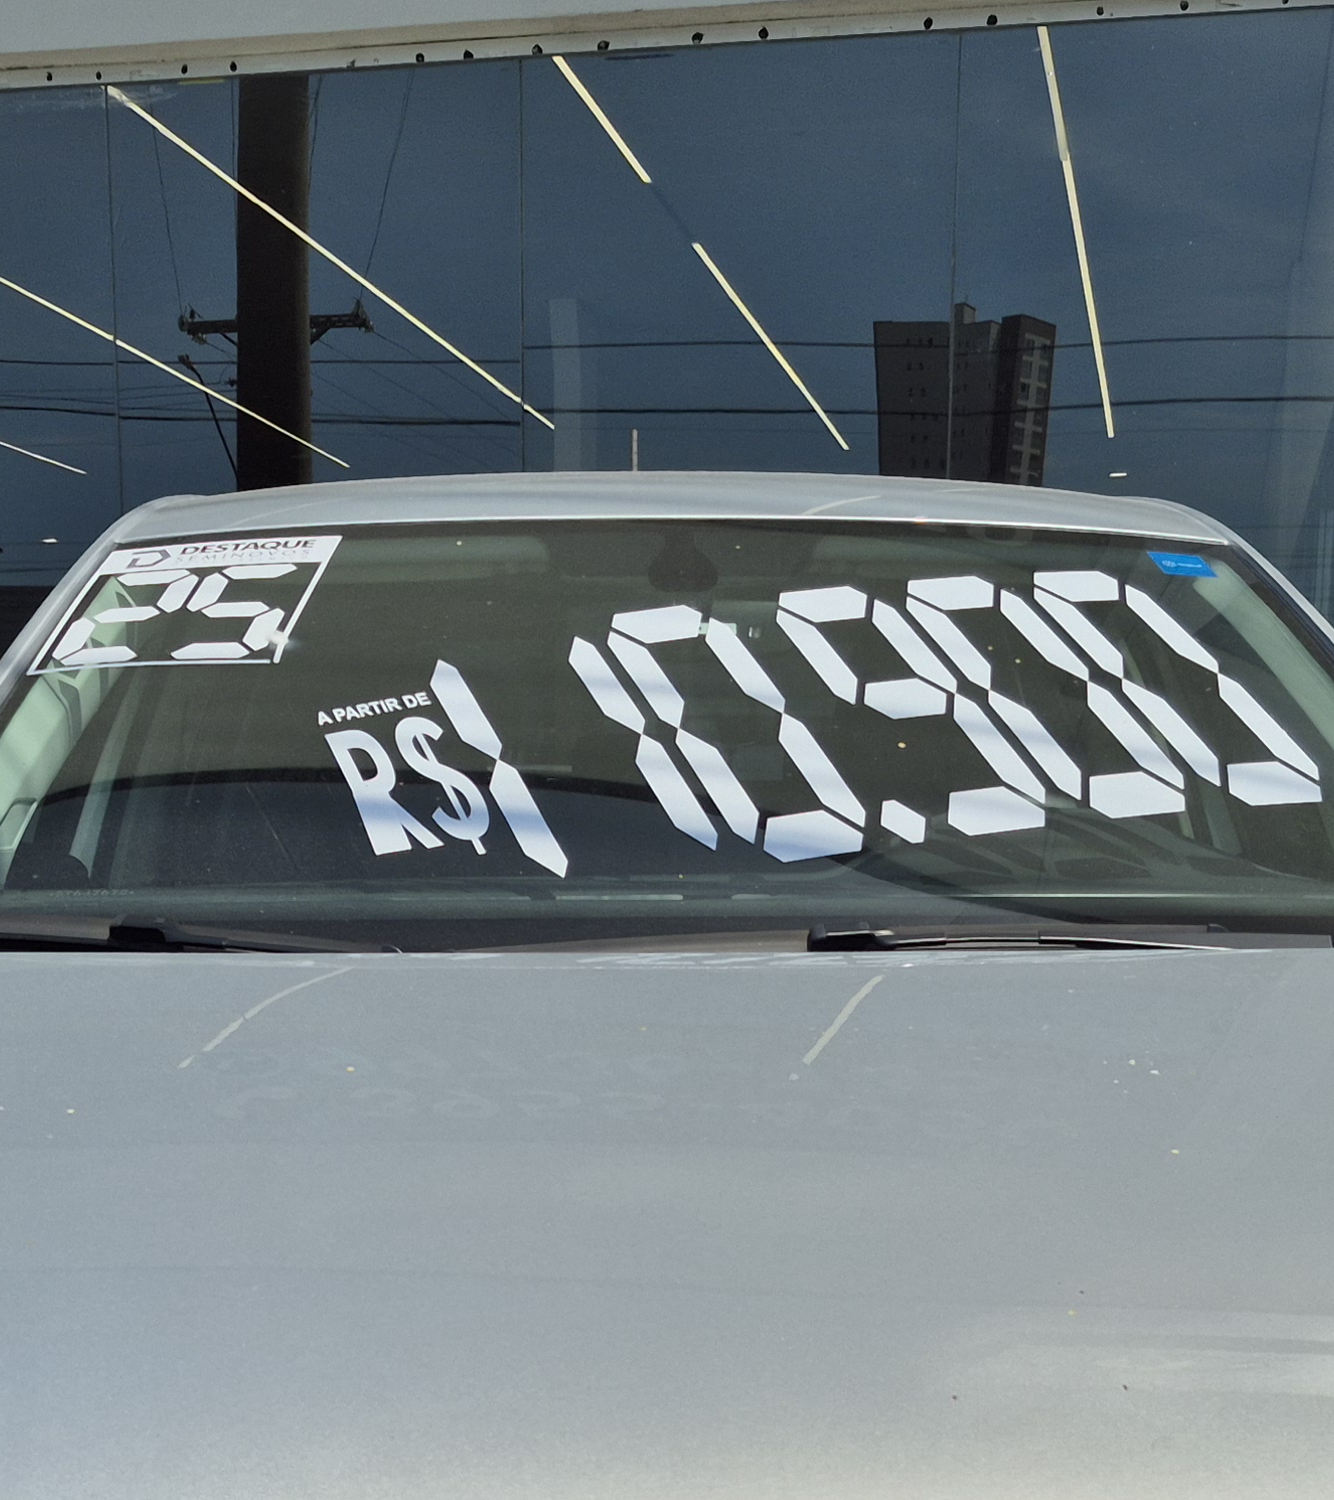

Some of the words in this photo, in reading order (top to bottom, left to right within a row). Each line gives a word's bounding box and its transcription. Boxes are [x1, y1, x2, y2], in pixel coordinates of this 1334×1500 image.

[180, 539, 317, 556] DESTAQUE
[52, 563, 298, 666] 25
[317, 710, 333, 726] A
[332, 697, 402, 722] PARTIR
[401, 691, 432, 710] DE
